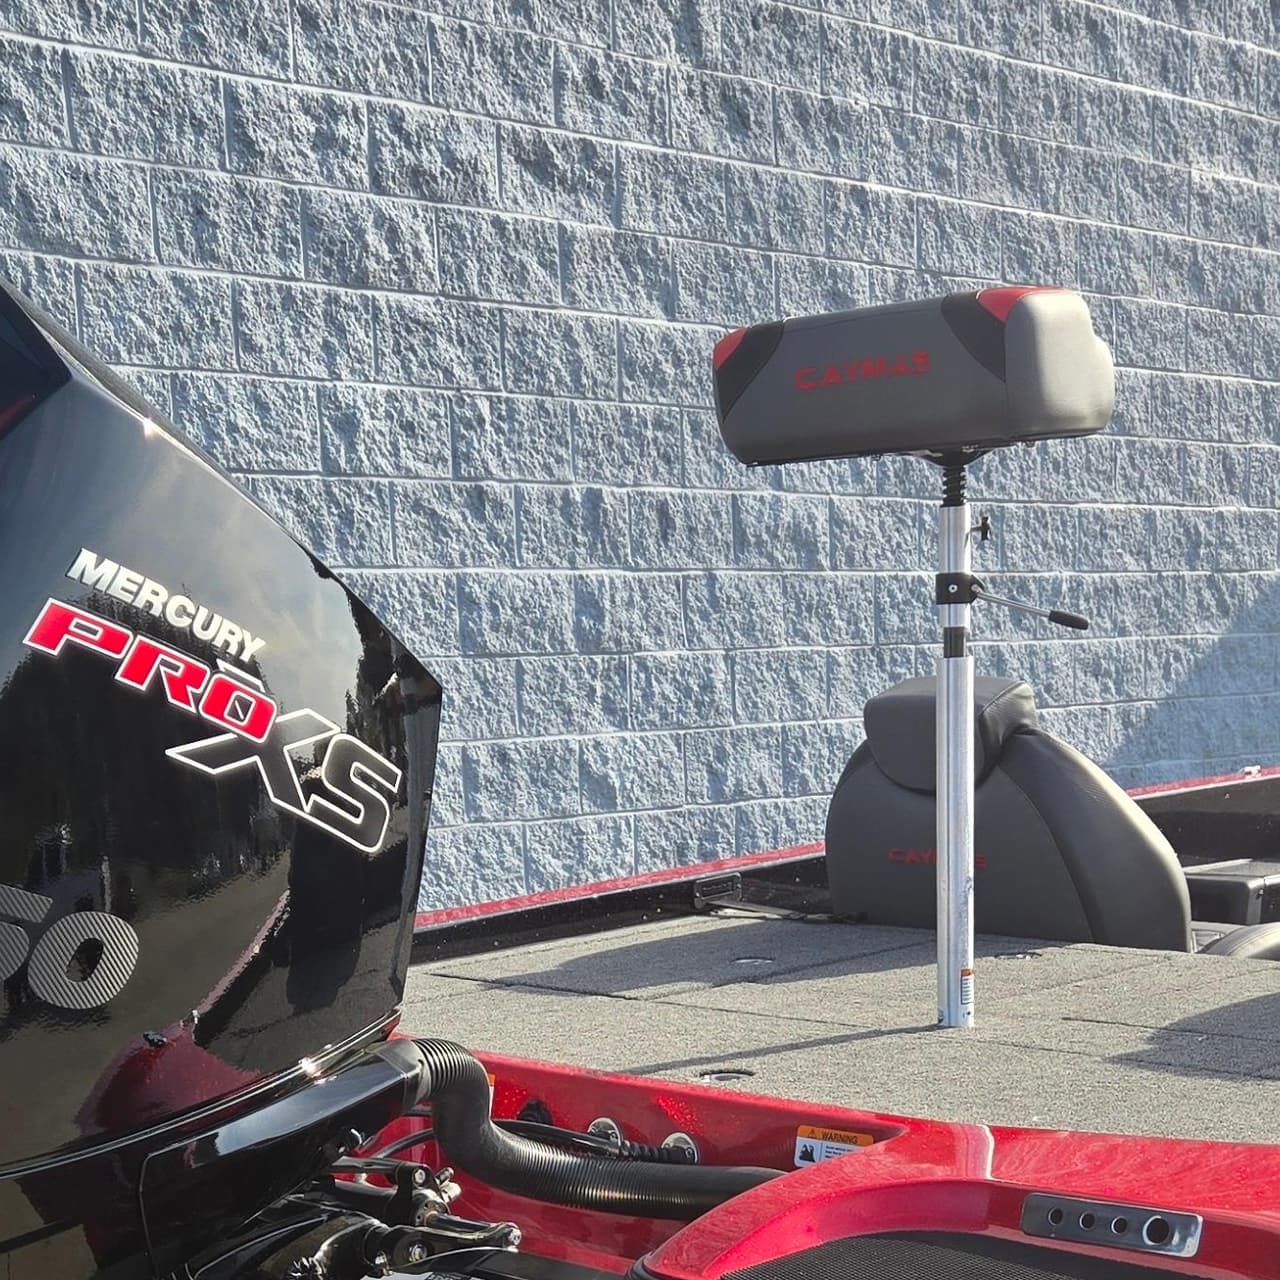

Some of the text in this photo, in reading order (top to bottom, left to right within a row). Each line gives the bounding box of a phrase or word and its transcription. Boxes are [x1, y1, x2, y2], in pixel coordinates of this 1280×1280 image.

[793, 350, 931, 393] CAYMAS
[65, 547, 267, 663] MERCURY
[22, 597, 278, 744] PRO
[887, 847, 988, 870] CAYS
[821, 1131, 859, 1145] WARNING
